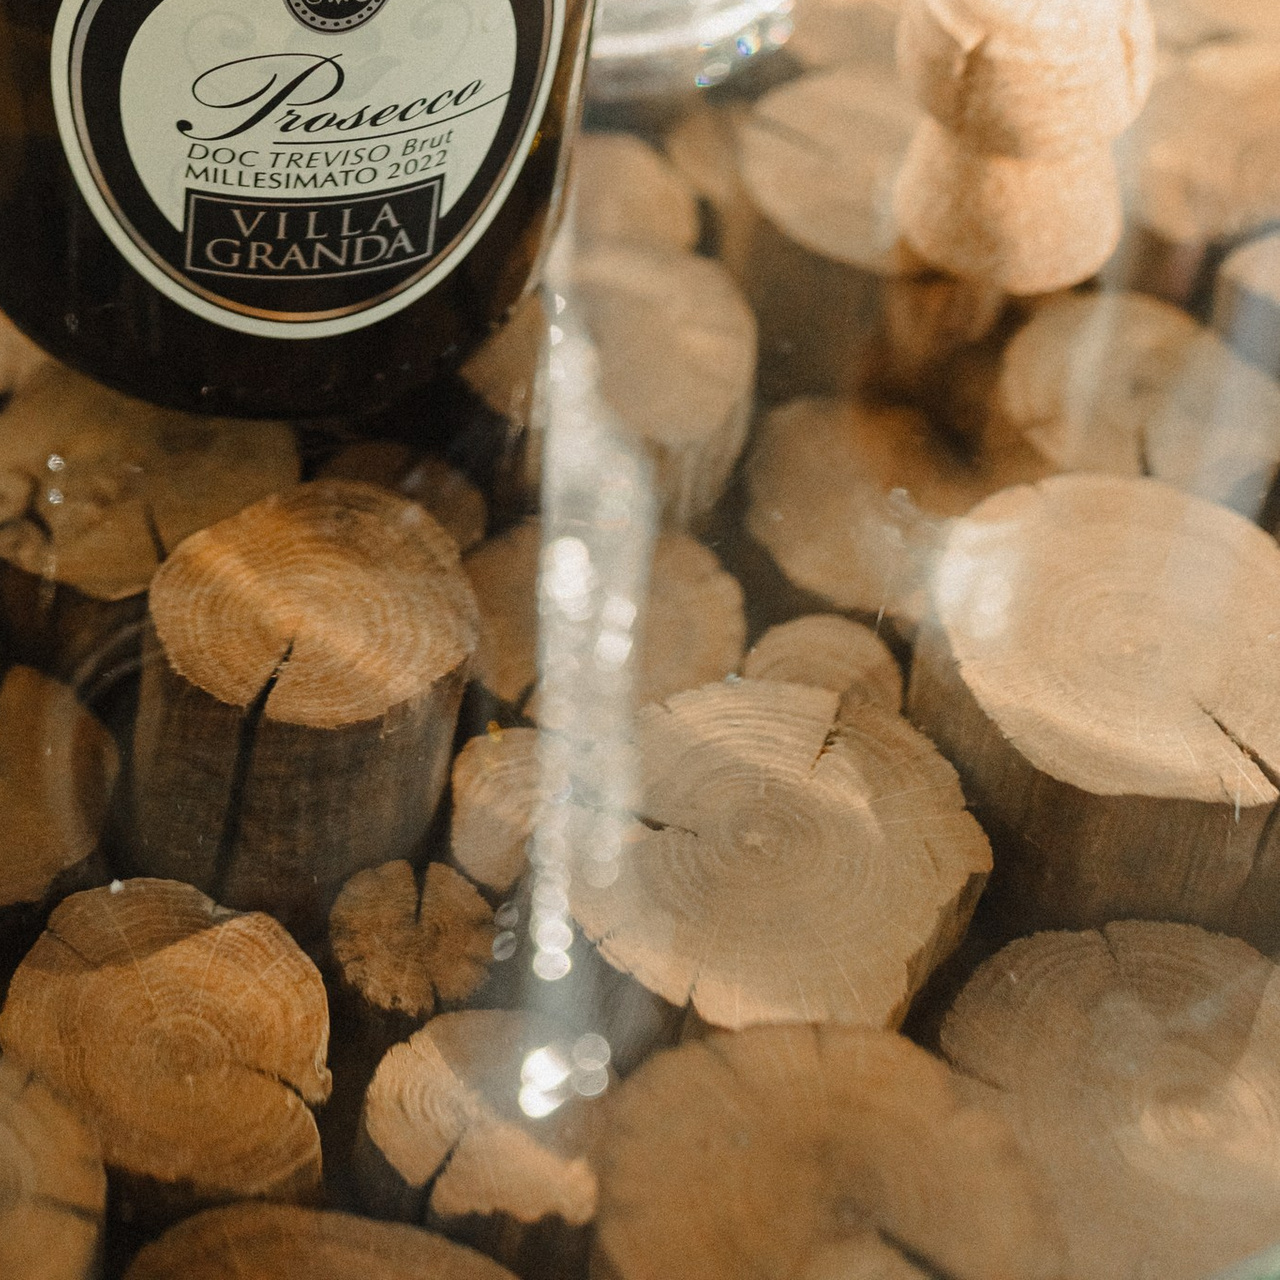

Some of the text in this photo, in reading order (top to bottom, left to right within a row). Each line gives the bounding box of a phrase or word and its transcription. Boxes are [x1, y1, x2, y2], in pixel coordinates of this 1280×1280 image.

[176, 53, 486, 141] Prosecco
[185, 149, 448, 189] MILLESIMATO 2022
[187, 129, 454, 169] DOC TREVISO Brut
[231, 202, 402, 239] VILLA
[205, 228, 415, 270] GRANDA
